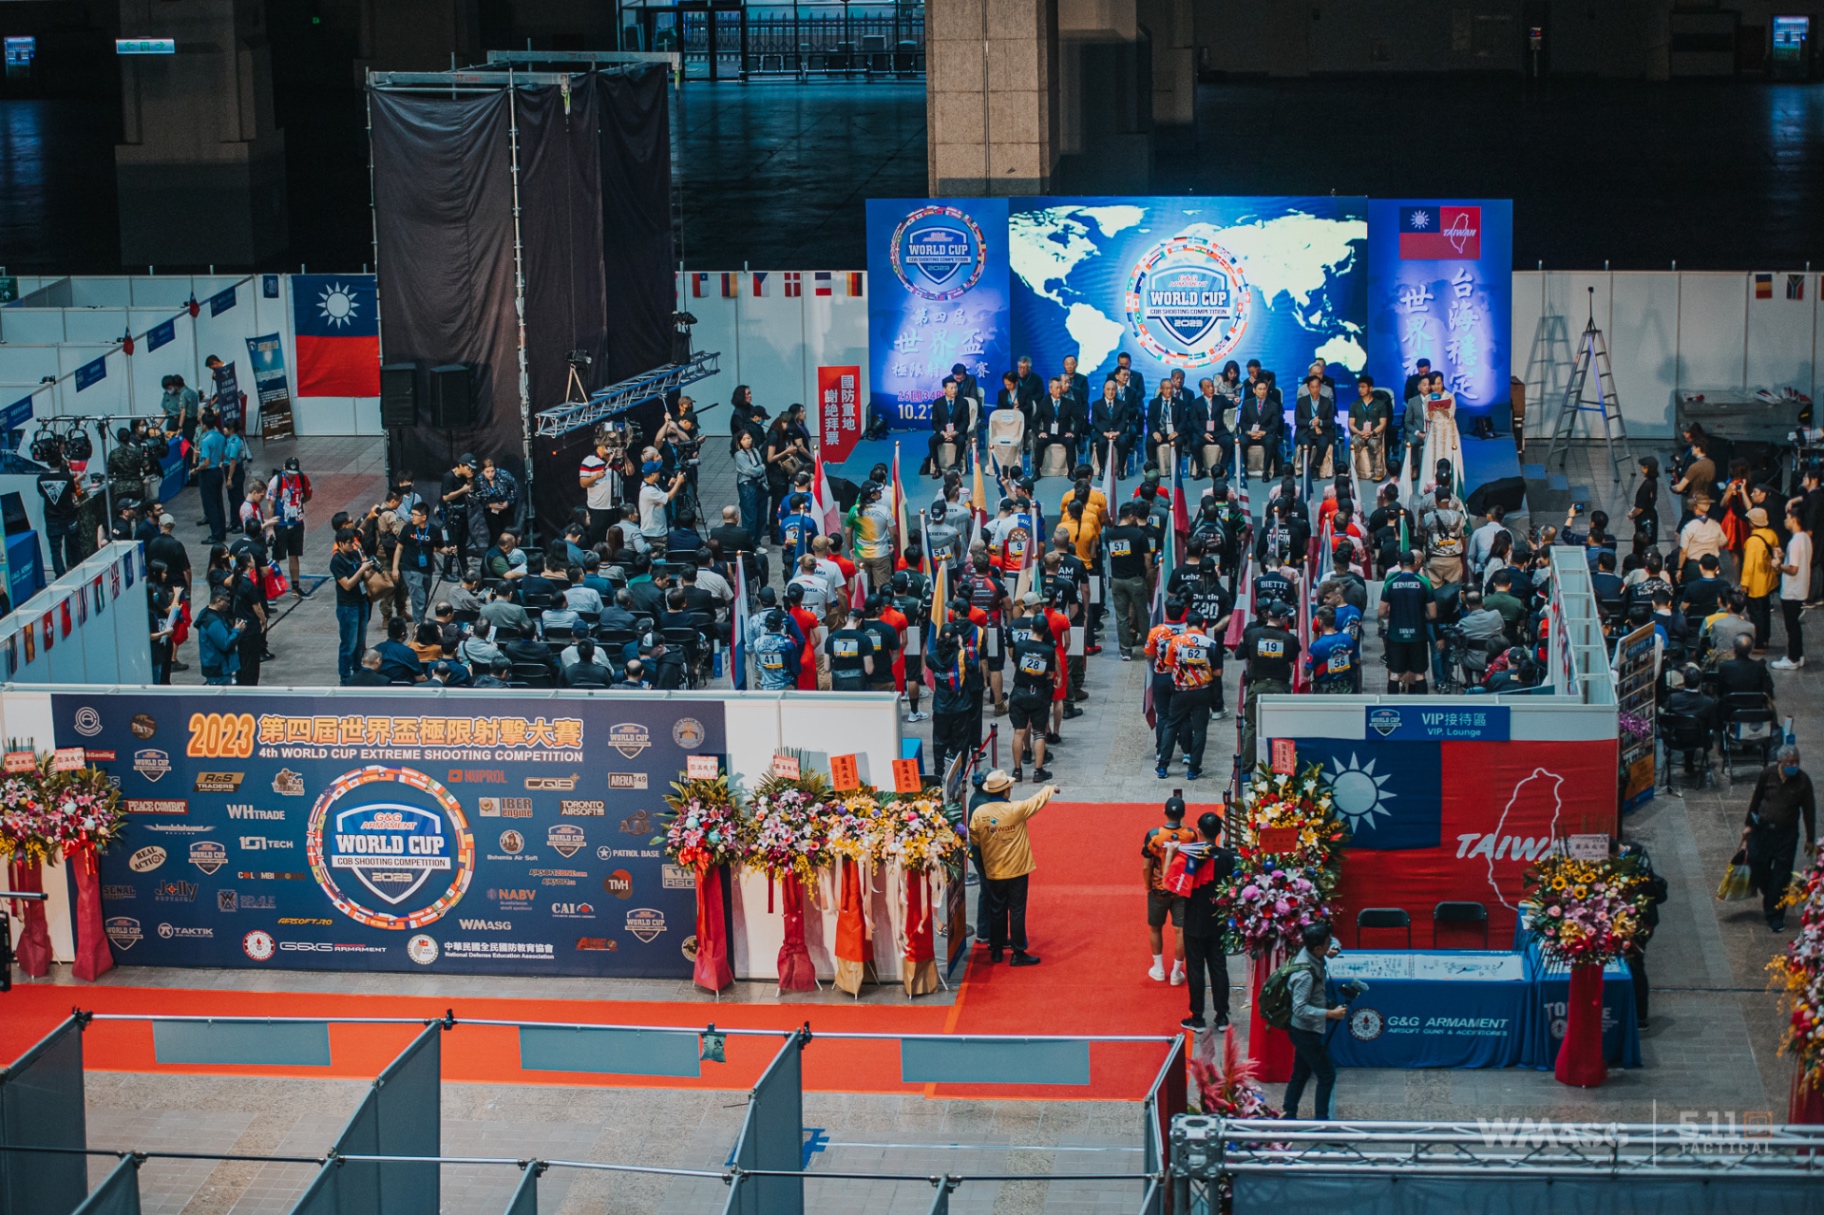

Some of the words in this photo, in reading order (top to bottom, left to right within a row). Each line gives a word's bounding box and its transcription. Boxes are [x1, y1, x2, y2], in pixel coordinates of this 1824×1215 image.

[1443, 228, 1476, 238] TAIWAN
[908, 244, 946, 255] WORLD
[948, 244, 969, 255] CUP
[1150, 291, 1199, 306] WORLD
[1201, 291, 1227, 307] CUP
[1174, 319, 1203, 327] 2023
[1446, 267, 1480, 400] 台海穩定
[894, 328, 985, 356] 世界盃
[841, 375, 856, 431] 國防重地
[824, 389, 839, 446] 謝絕拜票
[1016, 542, 1023, 551] 9
[1114, 541, 1125, 551] 57
[934, 548, 946, 557] 54
[1193, 593, 1219, 601] Jutin
[1017, 632, 1029, 641] 27
[842, 642, 849, 652] 7
[1264, 642, 1277, 652] 19
[1187, 648, 1201, 659] 62
[763, 655, 776, 665] 41
[1026, 658, 1040, 669] 28
[1334, 657, 1346, 668] 56
[1422, 712, 1487, 726] VIP接待區
[186, 712, 256, 758] 2023
[258, 714, 583, 750] 第四屆世界盃極限射擊大賽
[1446, 728, 1481, 737] Lounge
[259, 748, 278, 758] 4th
[281, 748, 328, 759] WORLD
[330, 749, 357, 759] CUP
[360, 749, 421, 760] EXTREME
[424, 750, 491, 761] SHOOTING
[494, 751, 583, 762] COMPETITION
[204, 774, 233, 782] R&S
[465, 770, 507, 783] NUPROL
[127, 801, 153, 811] PEACE
[154, 801, 186, 812] COMBAT
[501, 798, 533, 809] IBER
[561, 801, 604, 809] TORONTO
[375, 812, 402, 821] G&G
[501, 808, 533, 818] engine
[561, 808, 597, 816] AIRSOFT
[360, 821, 417, 830] ARMAMENT
[267, 840, 293, 848] TECH
[335, 834, 404, 854] WORLD
[408, 835, 445, 854] CUP
[1456, 833, 1562, 862] TAIWA
[136, 846, 157, 860] REAL
[612, 849, 639, 857] PATROL
[134, 852, 166, 870] ACTION
[354, 858, 393, 866] SHOOTING
[394, 859, 446, 867] COMPETITION
[372, 872, 413, 882] 2023
[608, 880, 629, 890] TMH
[499, 889, 536, 900] NABV
[552, 903, 575, 914] CAI
[459, 919, 512, 930] WMASG
[280, 941, 333, 952] G&G
[1387, 1016, 1420, 1027] G&G
[1425, 1017, 1509, 1029] ARMAMENT
